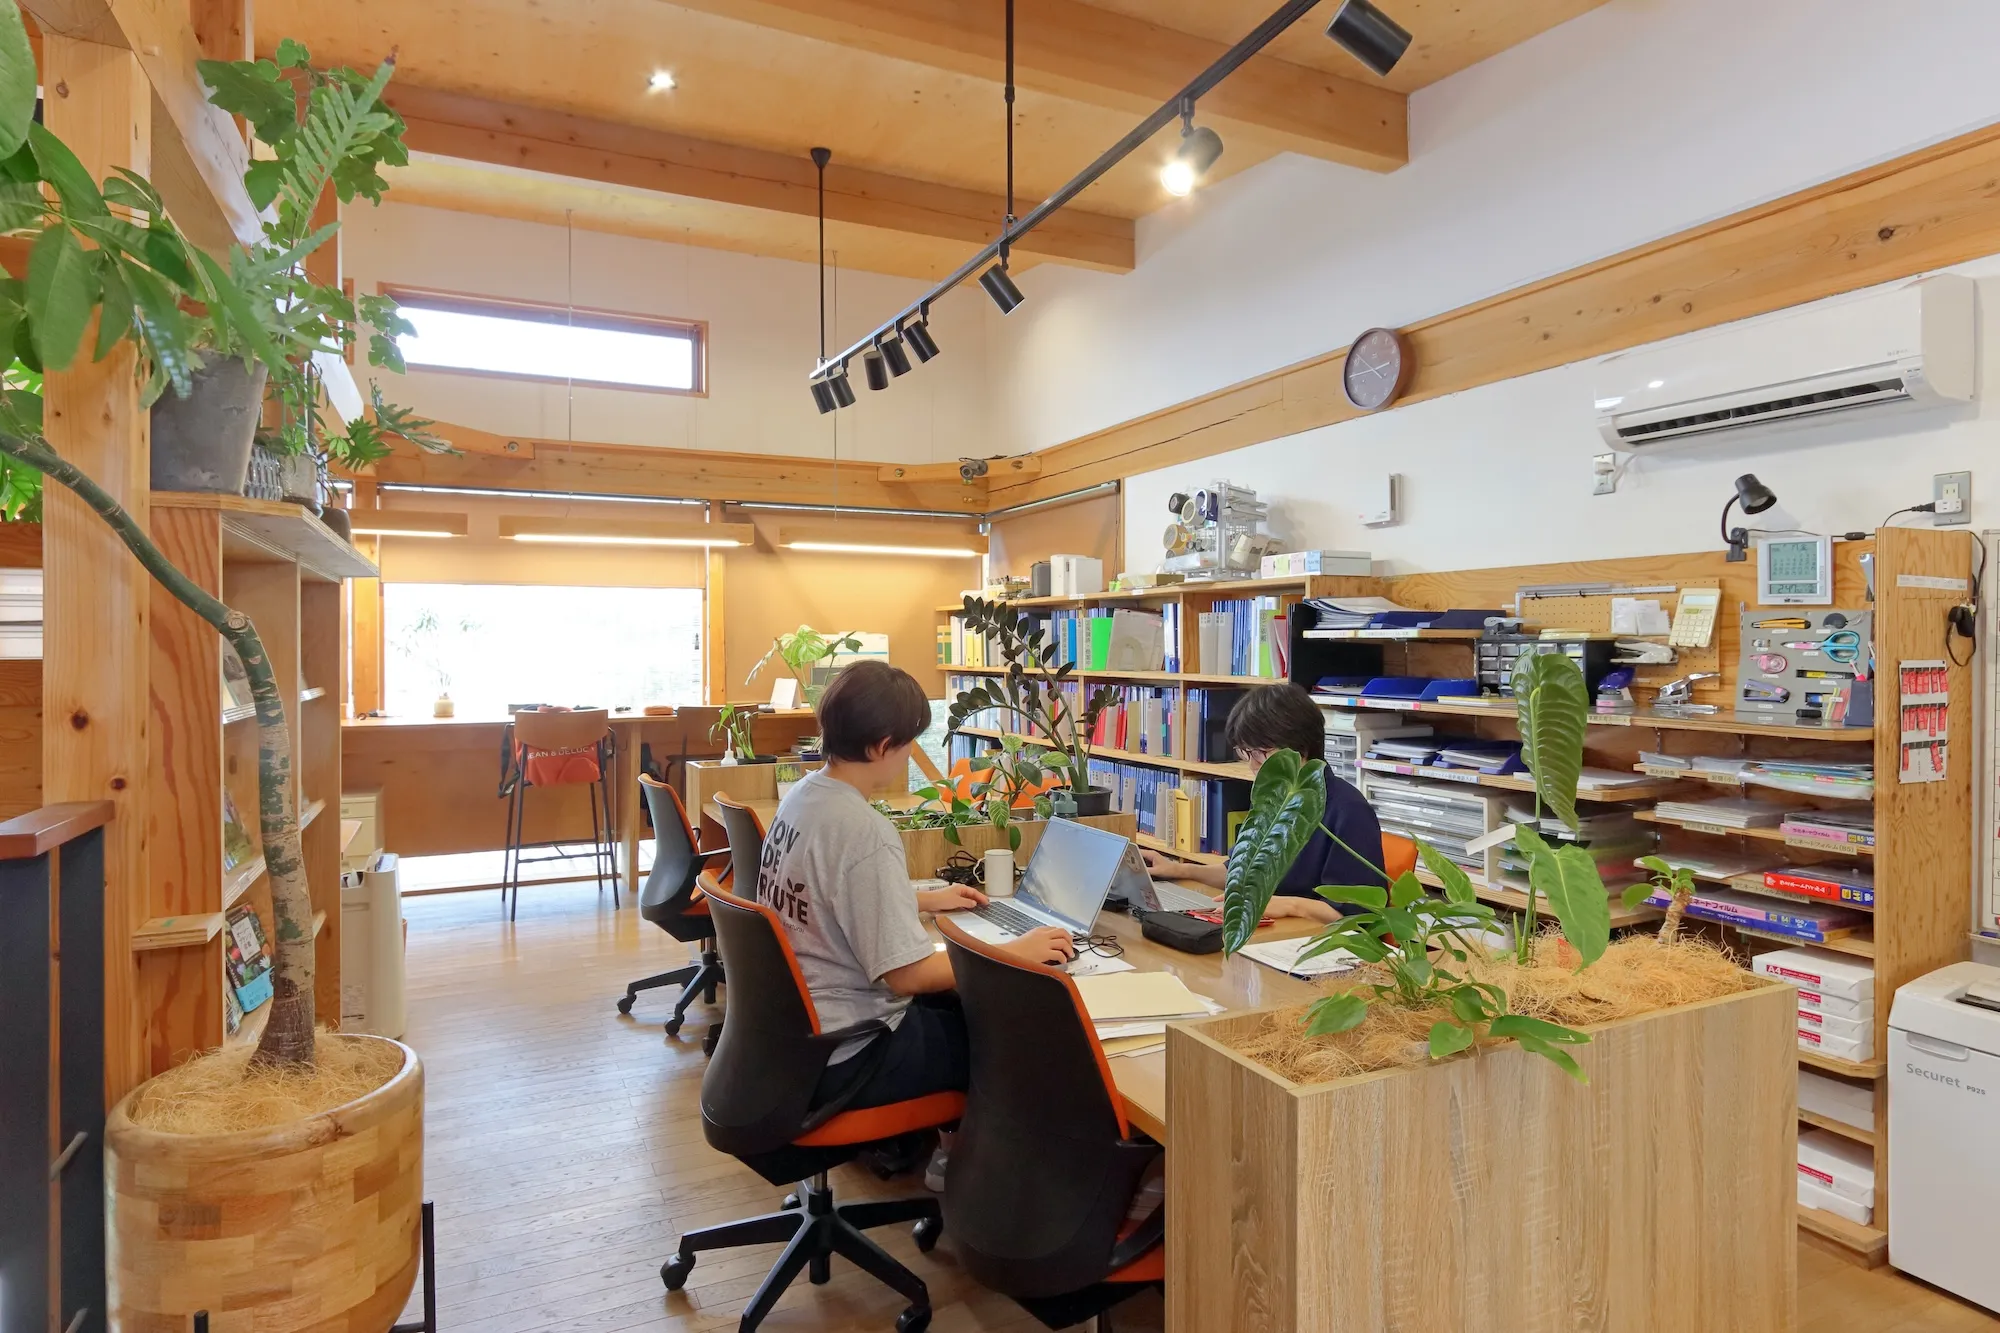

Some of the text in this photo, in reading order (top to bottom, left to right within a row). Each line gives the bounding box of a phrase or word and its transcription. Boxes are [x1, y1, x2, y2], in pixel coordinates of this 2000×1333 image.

[528, 751, 549, 760] EAN
[558, 747, 595, 756] DELUC
[1768, 965, 1782, 975] A4
[1906, 1062, 1961, 1088] Securet
